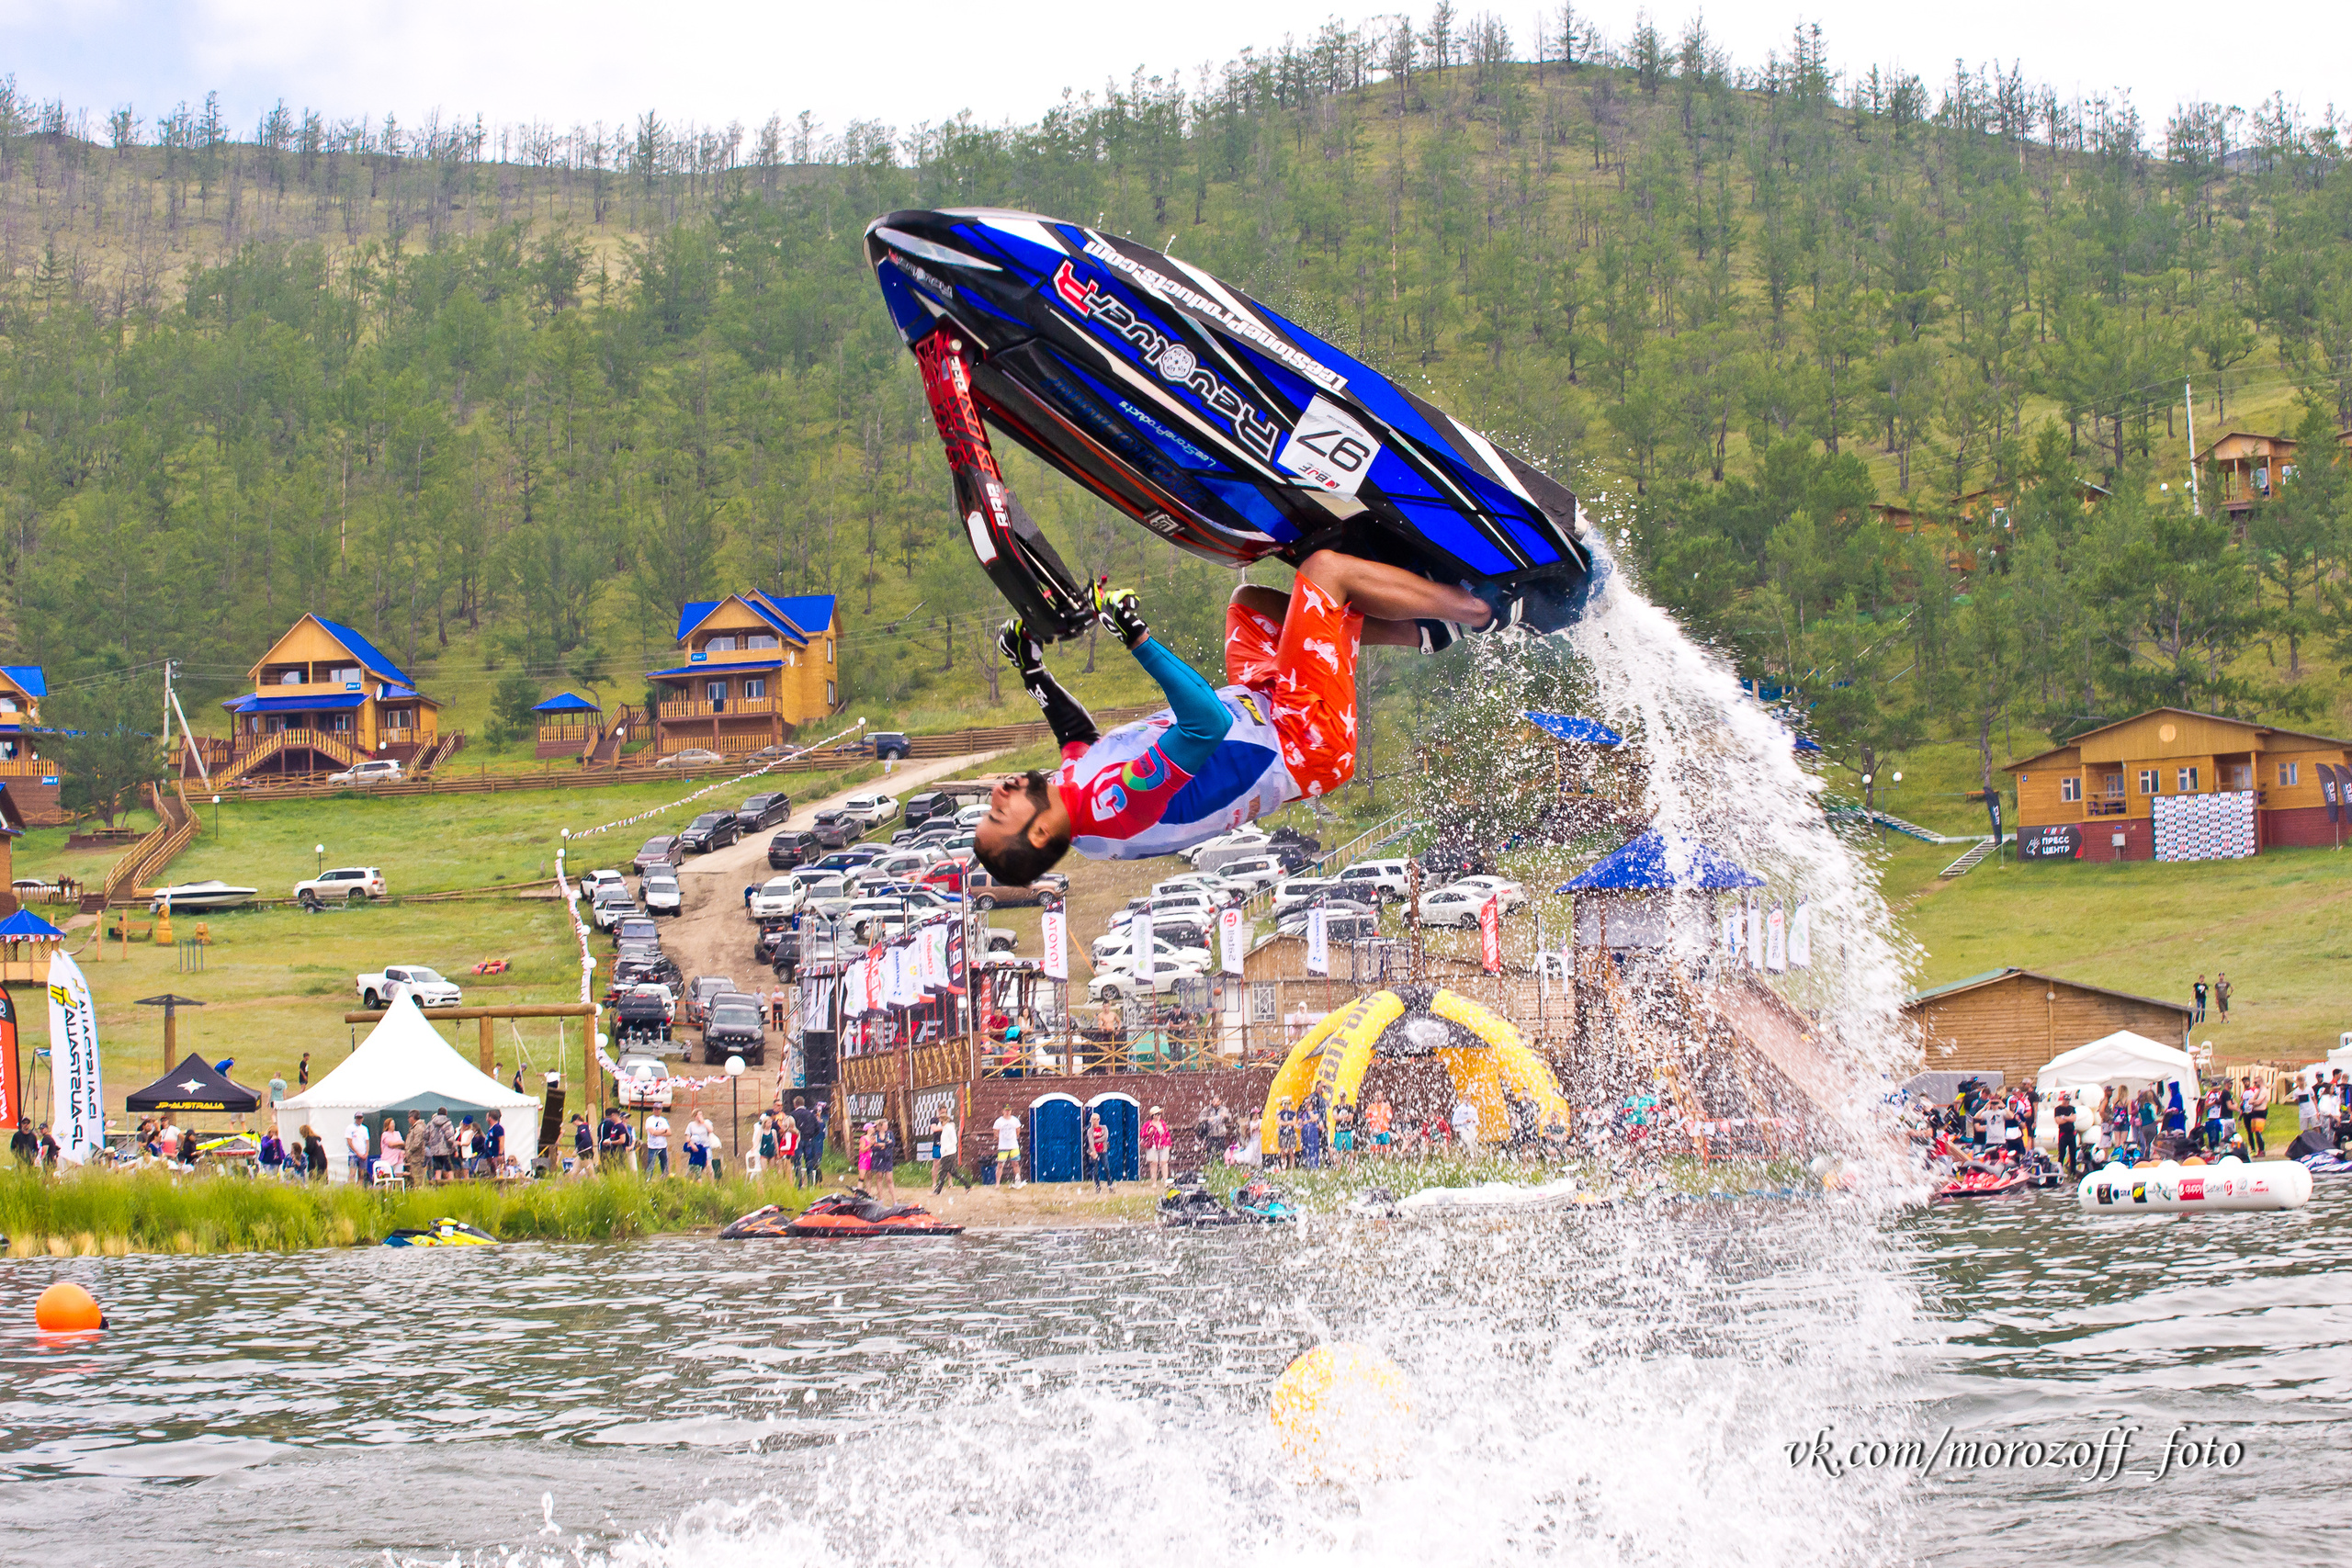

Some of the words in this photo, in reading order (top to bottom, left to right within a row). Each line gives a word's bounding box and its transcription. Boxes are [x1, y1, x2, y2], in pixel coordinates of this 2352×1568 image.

[1083, 240, 1349, 395] LeeStoneProducts.com
[1041, 374, 1114, 434] TURF
[1117, 399, 1217, 470] LeeStoneProducts
[1295, 431, 1371, 474] 97
[1298, 465, 1329, 484] BJF
[985, 483, 1009, 527] RRP
[2041, 836, 2070, 845] ПРЕСС
[2041, 845, 2070, 855] ЦЕНТР
[155, 1101, 225, 1110] JP-AUSTRALIA
